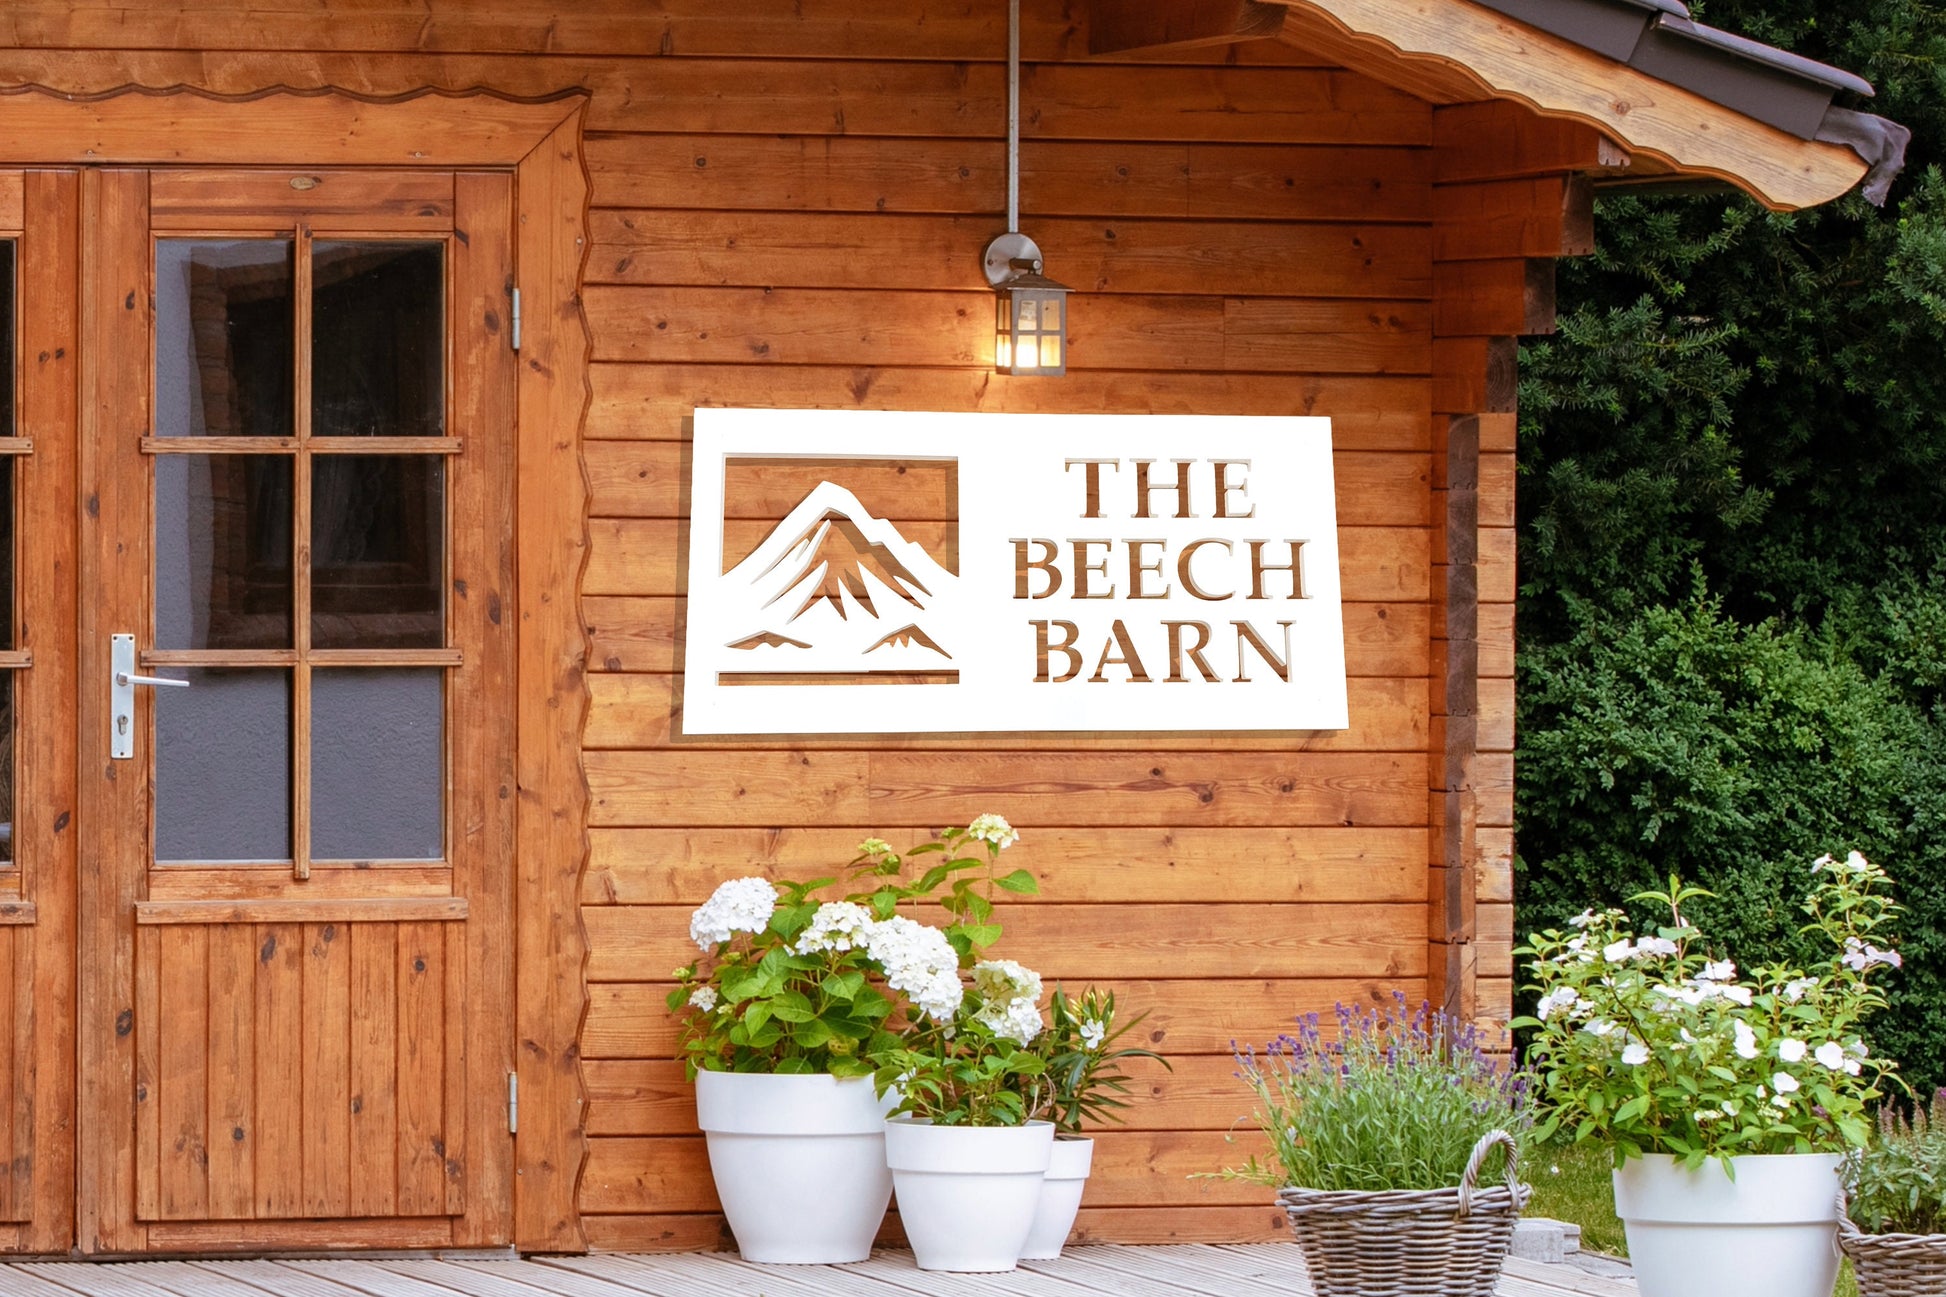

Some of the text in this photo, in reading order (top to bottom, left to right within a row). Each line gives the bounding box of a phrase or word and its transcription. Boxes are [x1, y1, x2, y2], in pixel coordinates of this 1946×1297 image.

[1064, 458, 1256, 518] THE
[1008, 537, 1314, 601] BEECH
[1028, 619, 1297, 683] BARN
